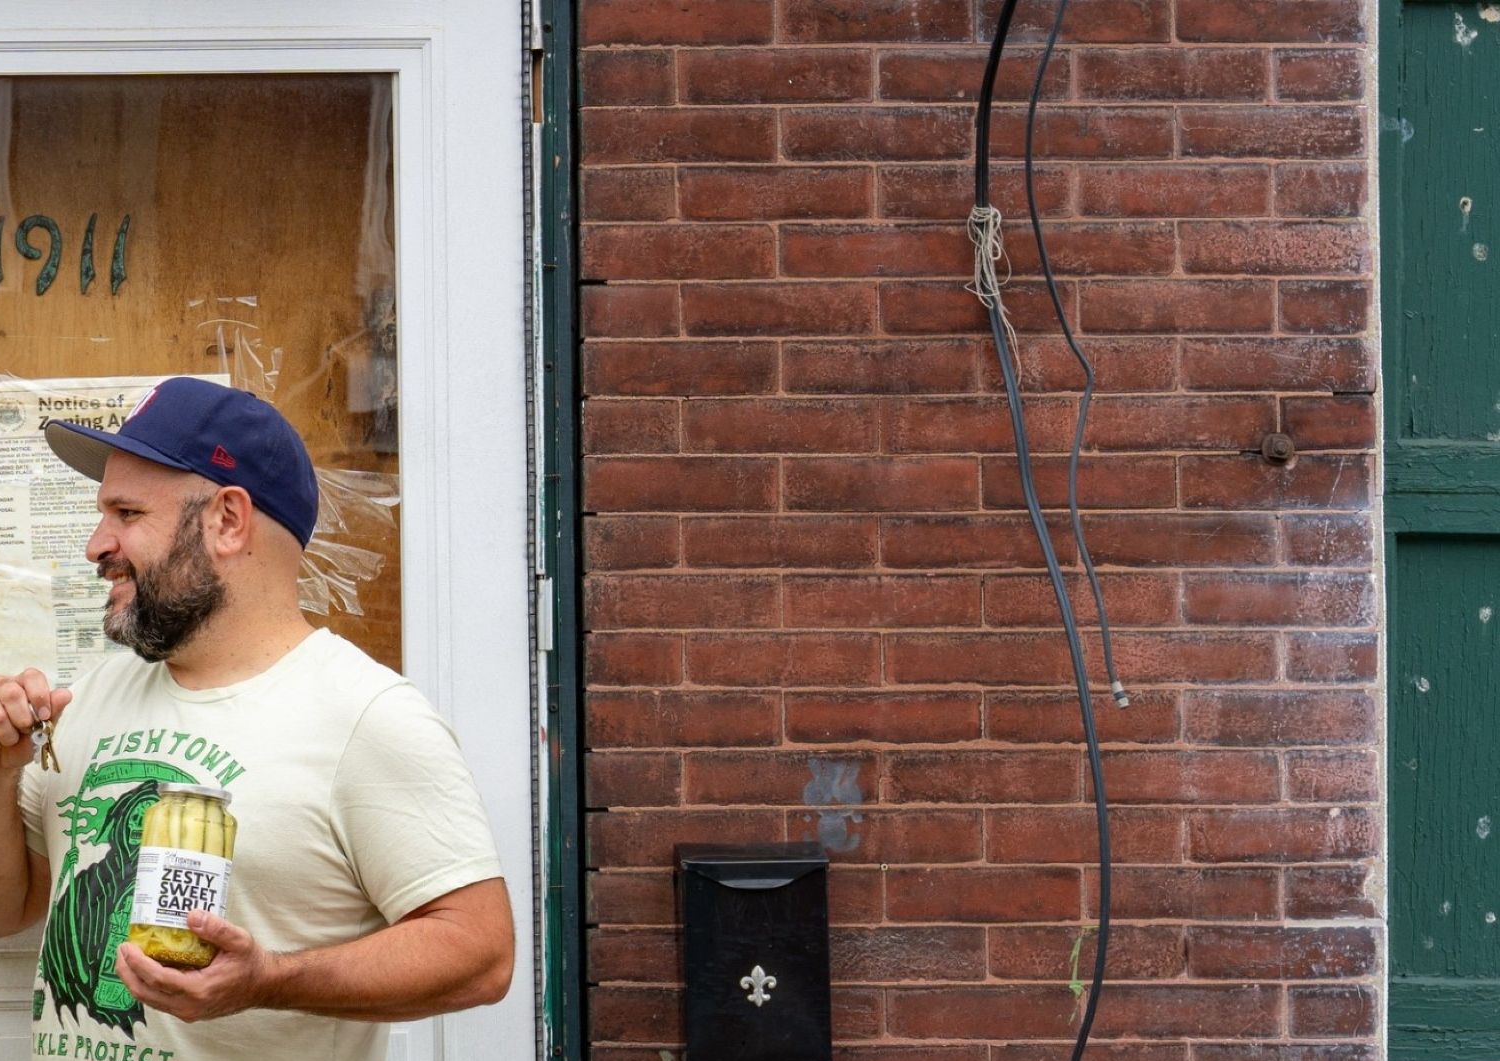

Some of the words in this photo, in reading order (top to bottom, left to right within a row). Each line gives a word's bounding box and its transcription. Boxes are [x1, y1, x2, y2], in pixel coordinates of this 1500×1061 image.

[38, 395, 100, 412] Notice
[106, 393, 124, 408] of
[38, 414, 104, 431] Zing
[91, 729, 247, 788] FISHTOWN
[161, 868, 215, 888] ZESTY
[160, 881, 218, 902] SWEET
